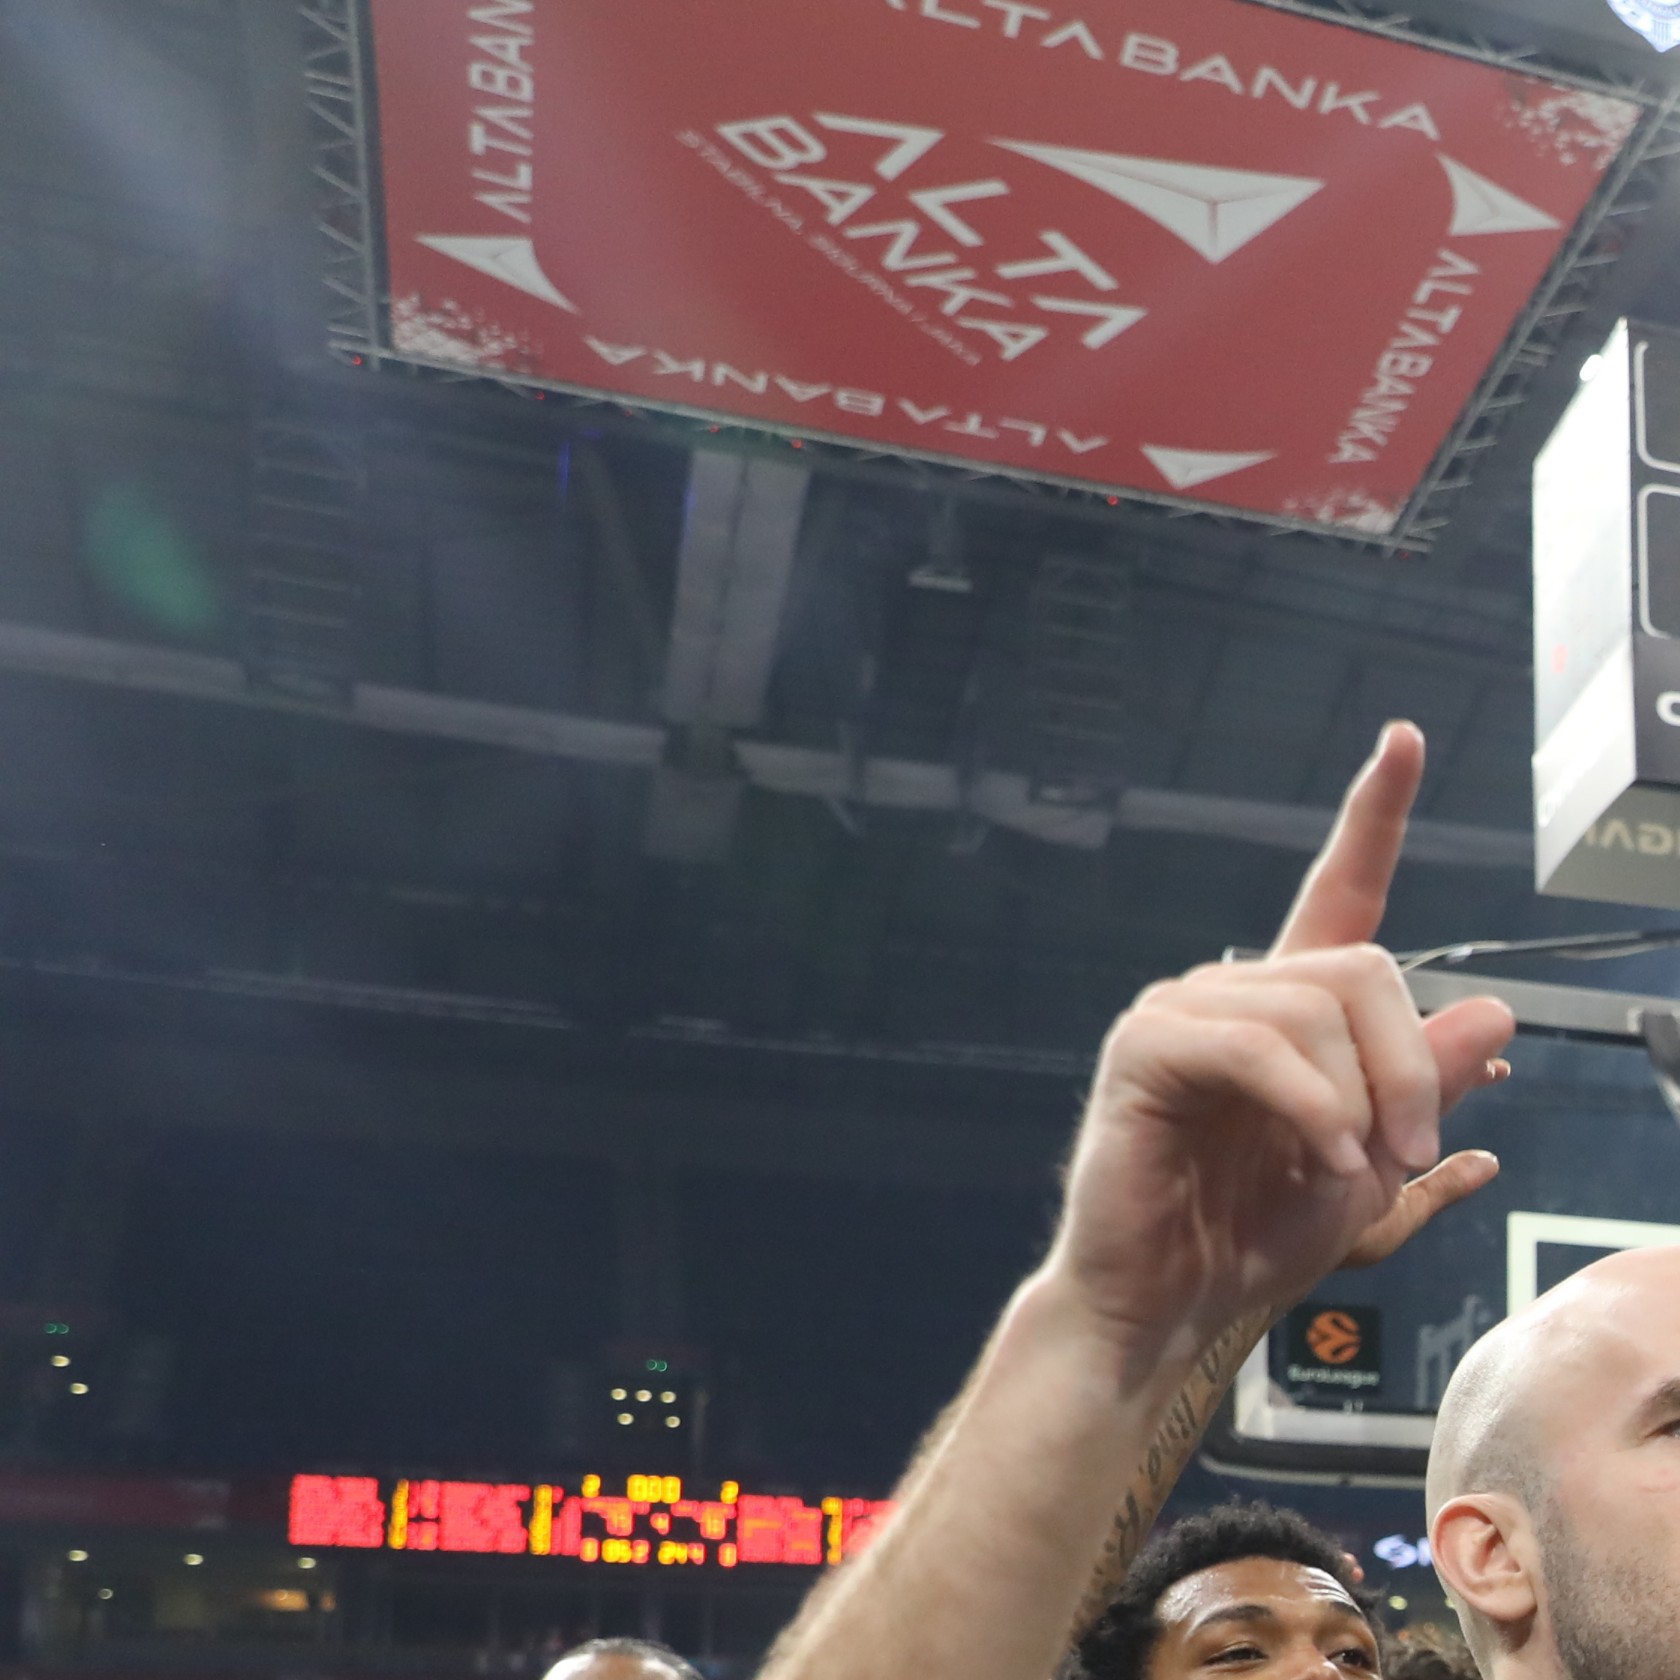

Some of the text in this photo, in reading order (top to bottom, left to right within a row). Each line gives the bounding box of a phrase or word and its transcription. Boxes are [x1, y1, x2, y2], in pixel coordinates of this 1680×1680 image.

[467, 0, 535, 224] ALTABAN
[888, 0, 1441, 141] LTABANKA
[716, 115, 1049, 361] BANKA
[812, 111, 1148, 350] ALTA
[585, 335, 1107, 454] ALTABANKA
[1326, 248, 1481, 463] ALTABANKA
